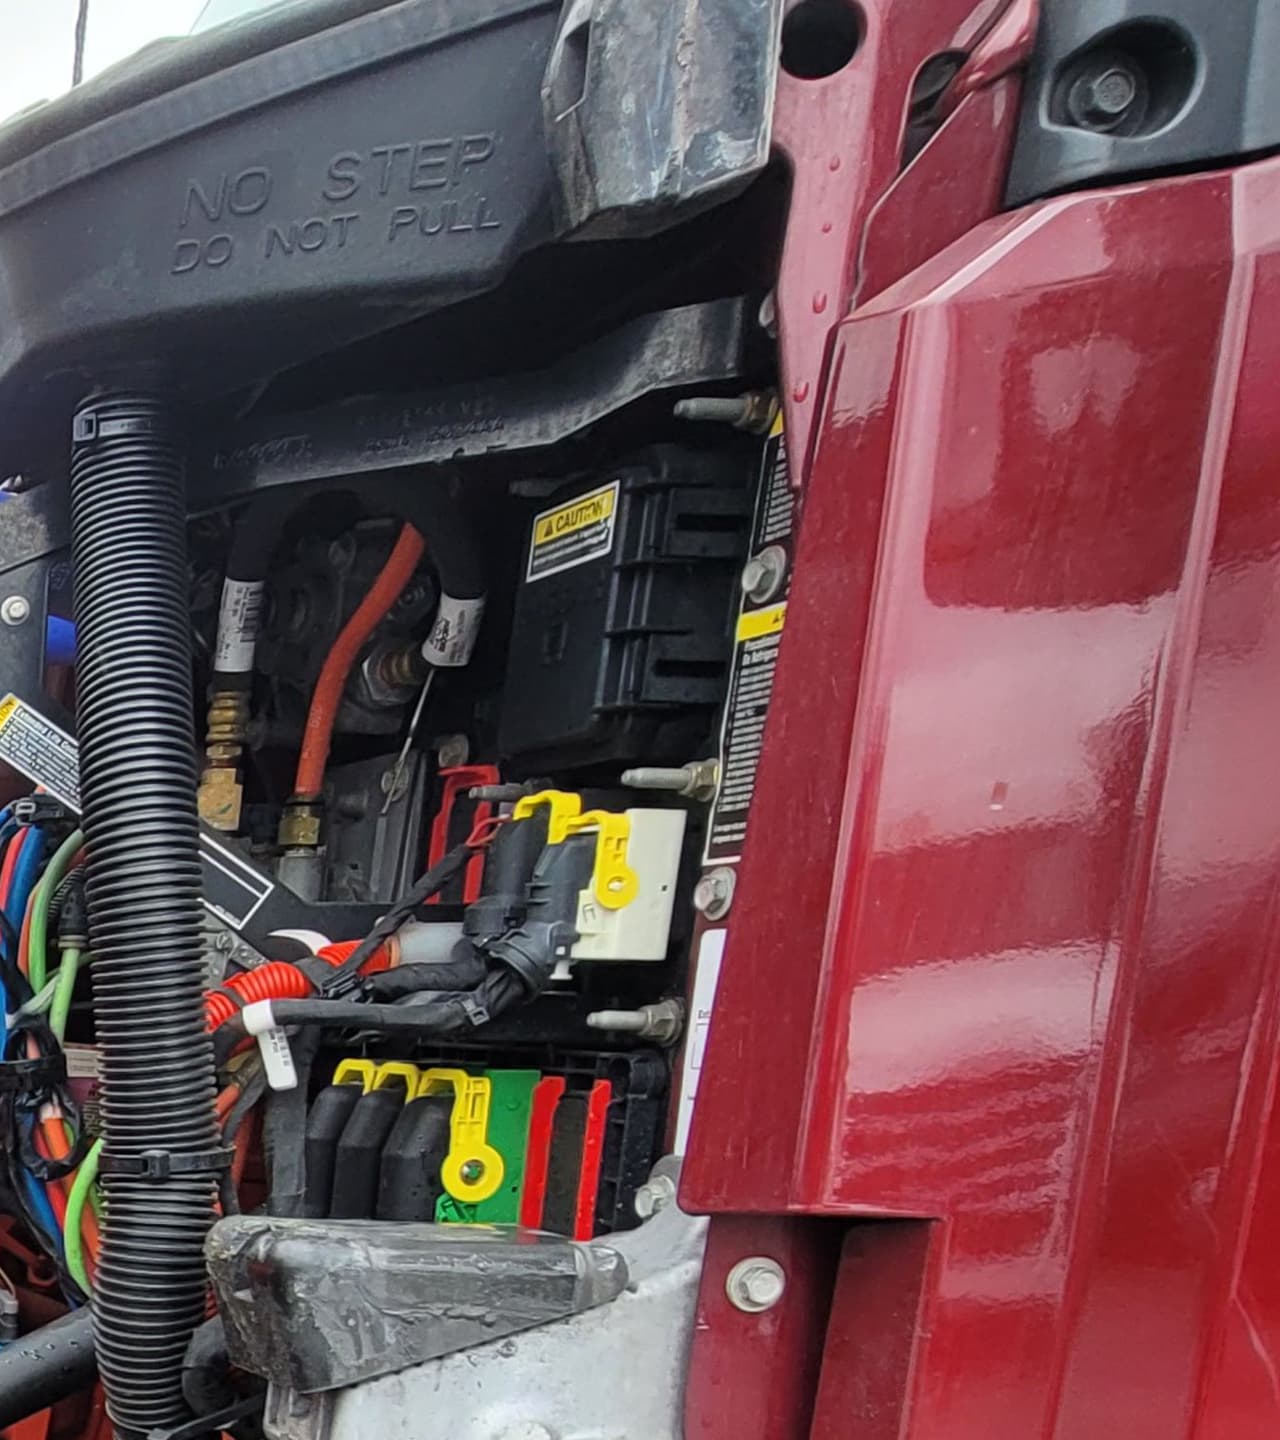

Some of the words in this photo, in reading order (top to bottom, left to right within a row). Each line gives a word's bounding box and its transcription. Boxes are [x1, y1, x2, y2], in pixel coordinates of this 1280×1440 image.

[179, 166, 271, 228] NO
[322, 133, 497, 201] STEP
[171, 233, 233, 275] DO
[263, 213, 360, 258] NOT
[389, 197, 501, 241] PULL
[556, 501, 605, 531] CAUTION
